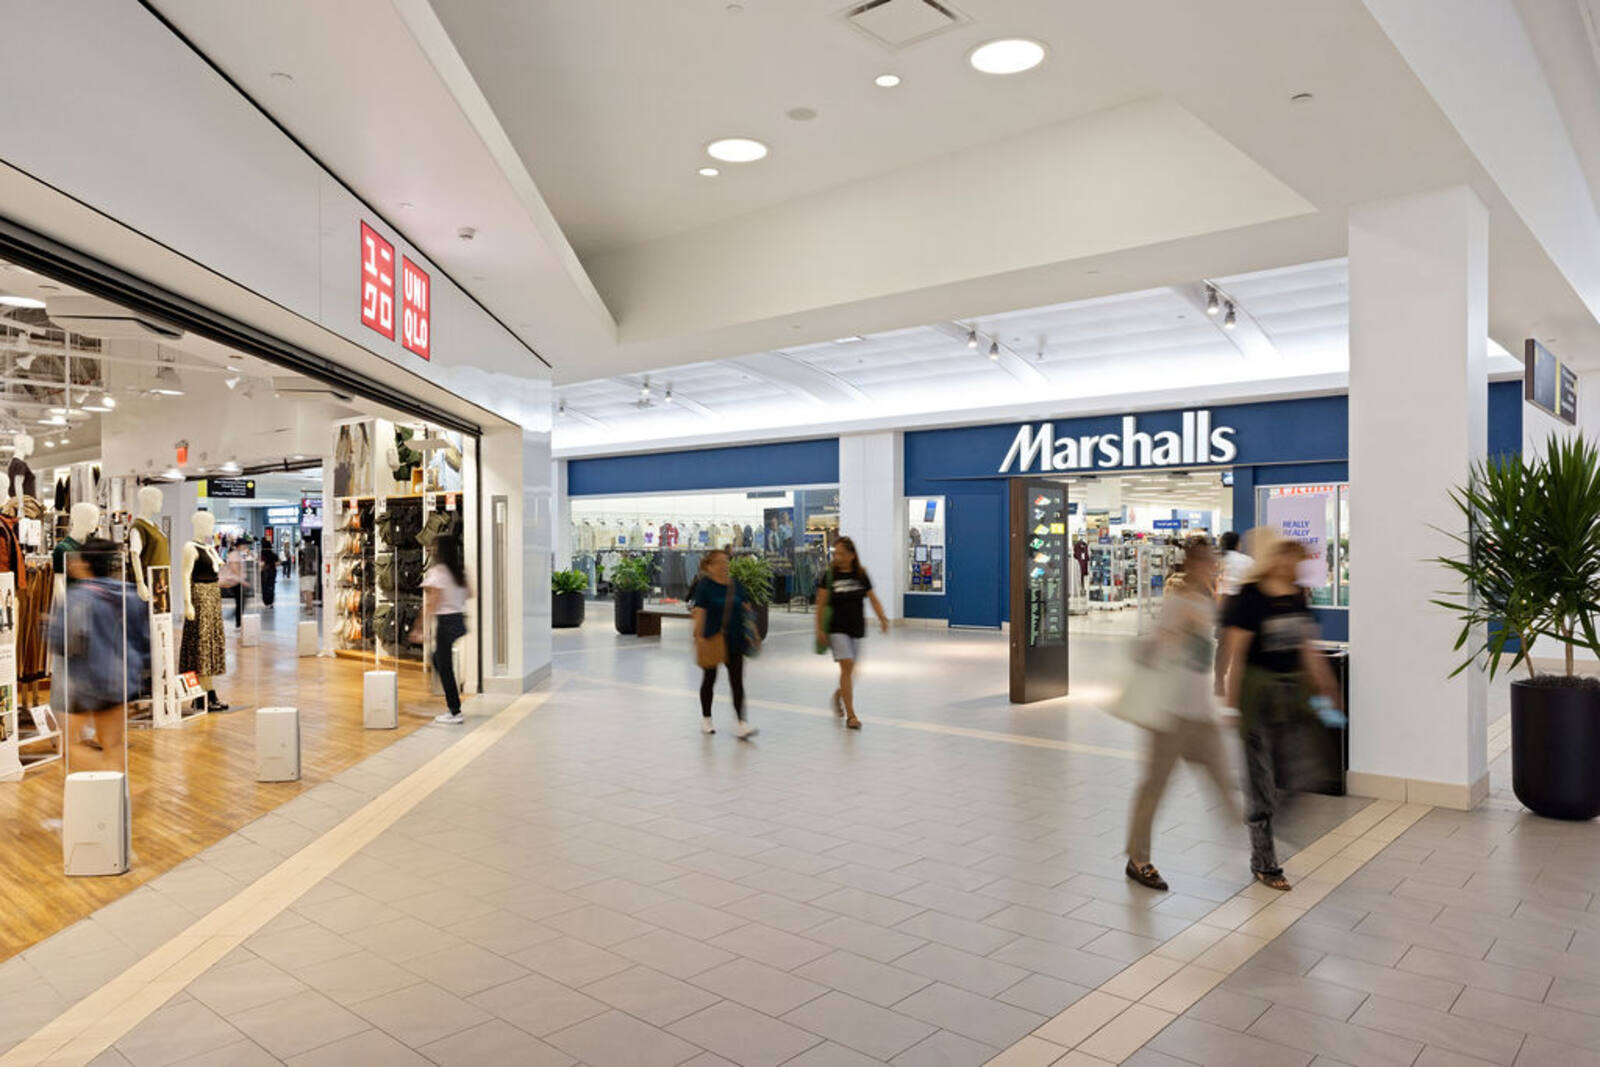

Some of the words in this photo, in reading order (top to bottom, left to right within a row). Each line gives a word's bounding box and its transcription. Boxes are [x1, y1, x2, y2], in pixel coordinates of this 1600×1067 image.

[364, 236, 392, 288] ユニ
[363, 283, 392, 330] クロ
[404, 267, 426, 312] UNI
[404, 309, 428, 349] QLO
[998, 410, 1237, 473] Marshalls
[1282, 520, 1310, 528] REALLY
[1282, 529, 1310, 537] REALLY
